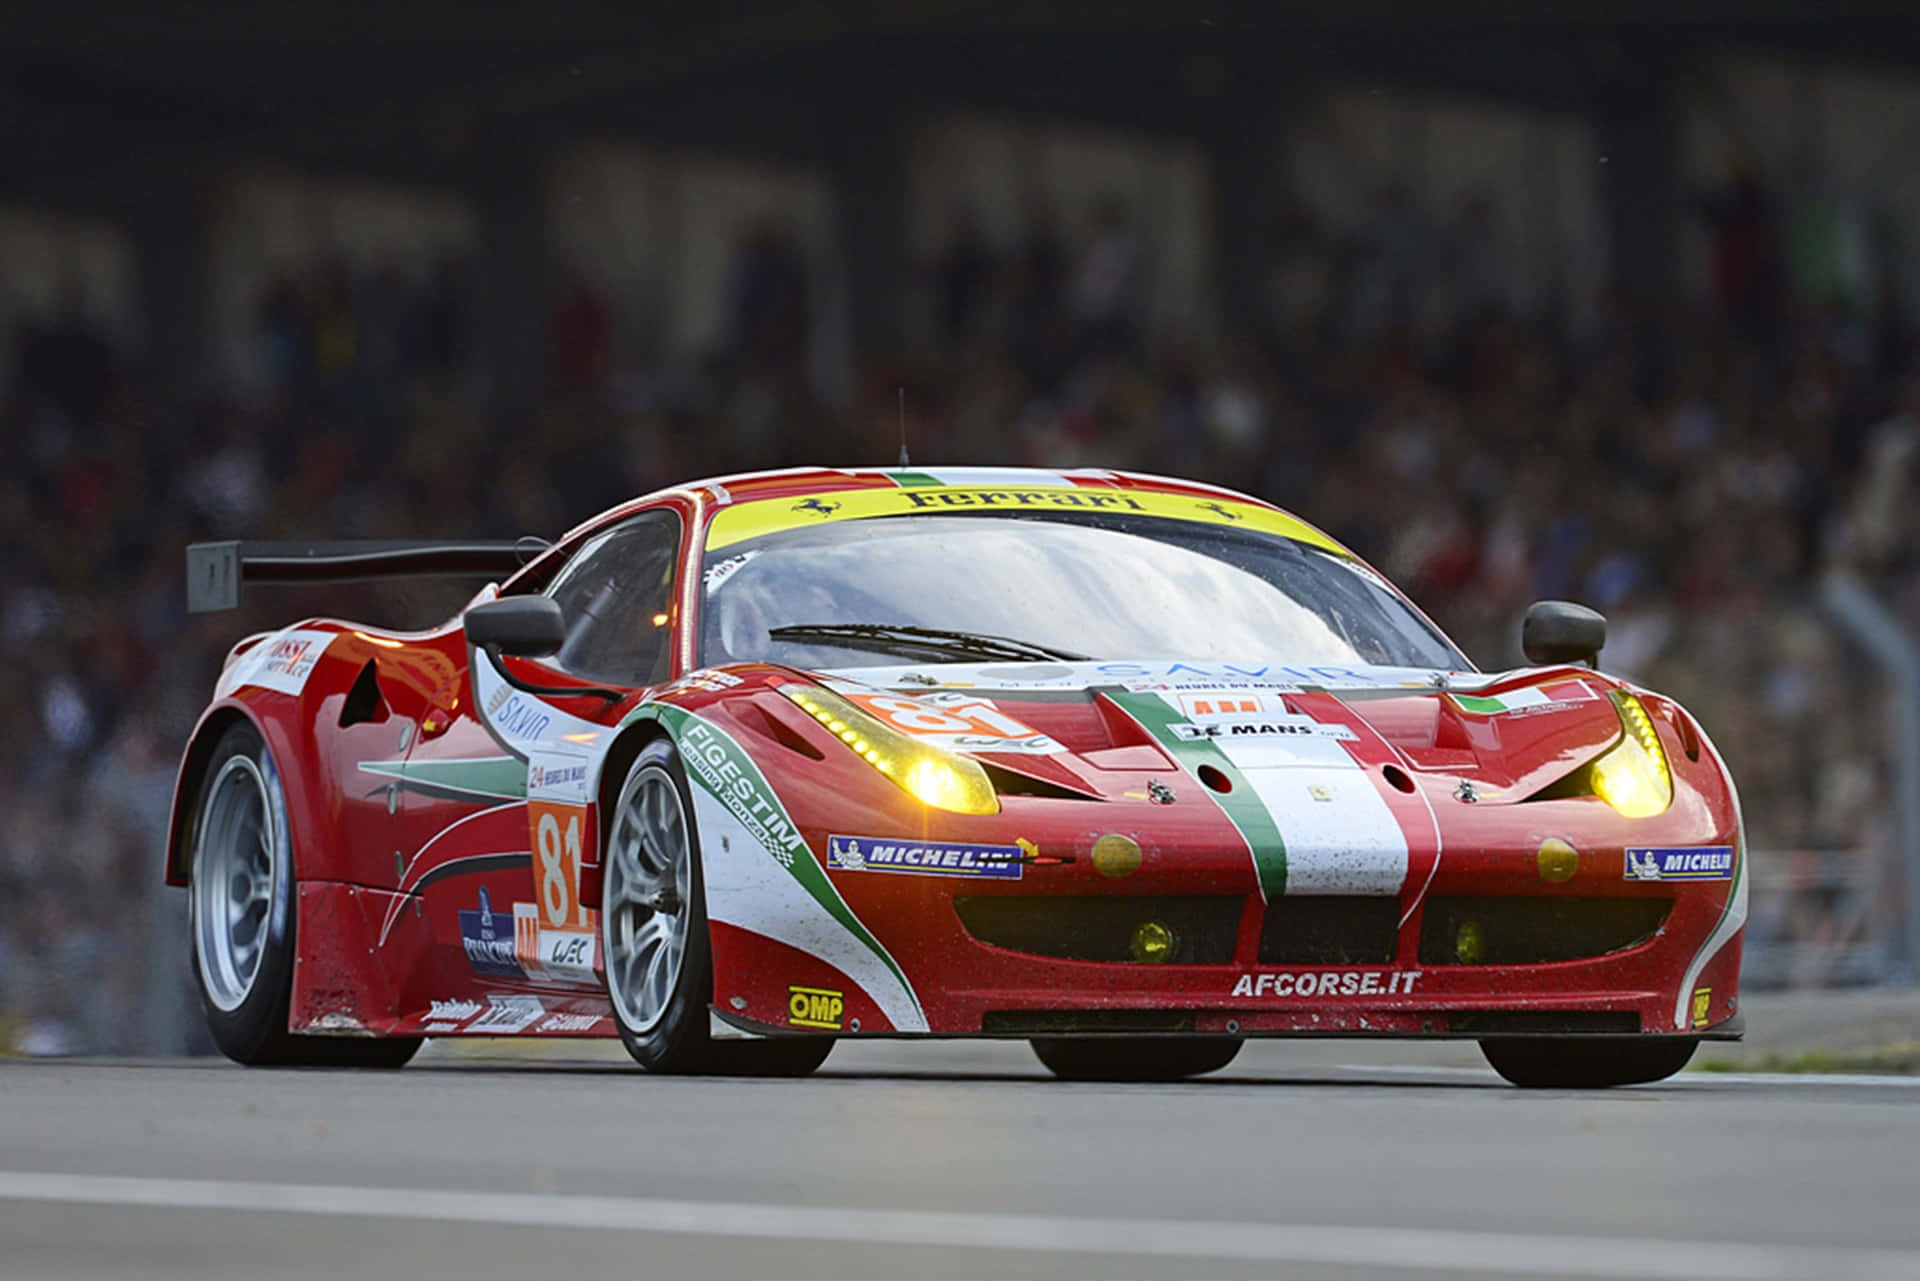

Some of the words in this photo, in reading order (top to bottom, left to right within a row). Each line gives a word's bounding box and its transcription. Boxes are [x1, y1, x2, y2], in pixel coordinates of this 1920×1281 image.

[899, 488, 1147, 511] Ferrari
[869, 697, 1033, 736] 81
[1231, 724, 1313, 735] MANS
[687, 724, 803, 851] FIGESTIM
[720, 786, 773, 843] Monza
[537, 812, 589, 928] 81
[869, 845, 1012, 869] MICHELIN
[552, 938, 588, 964] WEC
[1231, 971, 1423, 997] AFCORSE.IT
[790, 993, 843, 1022] OMP
